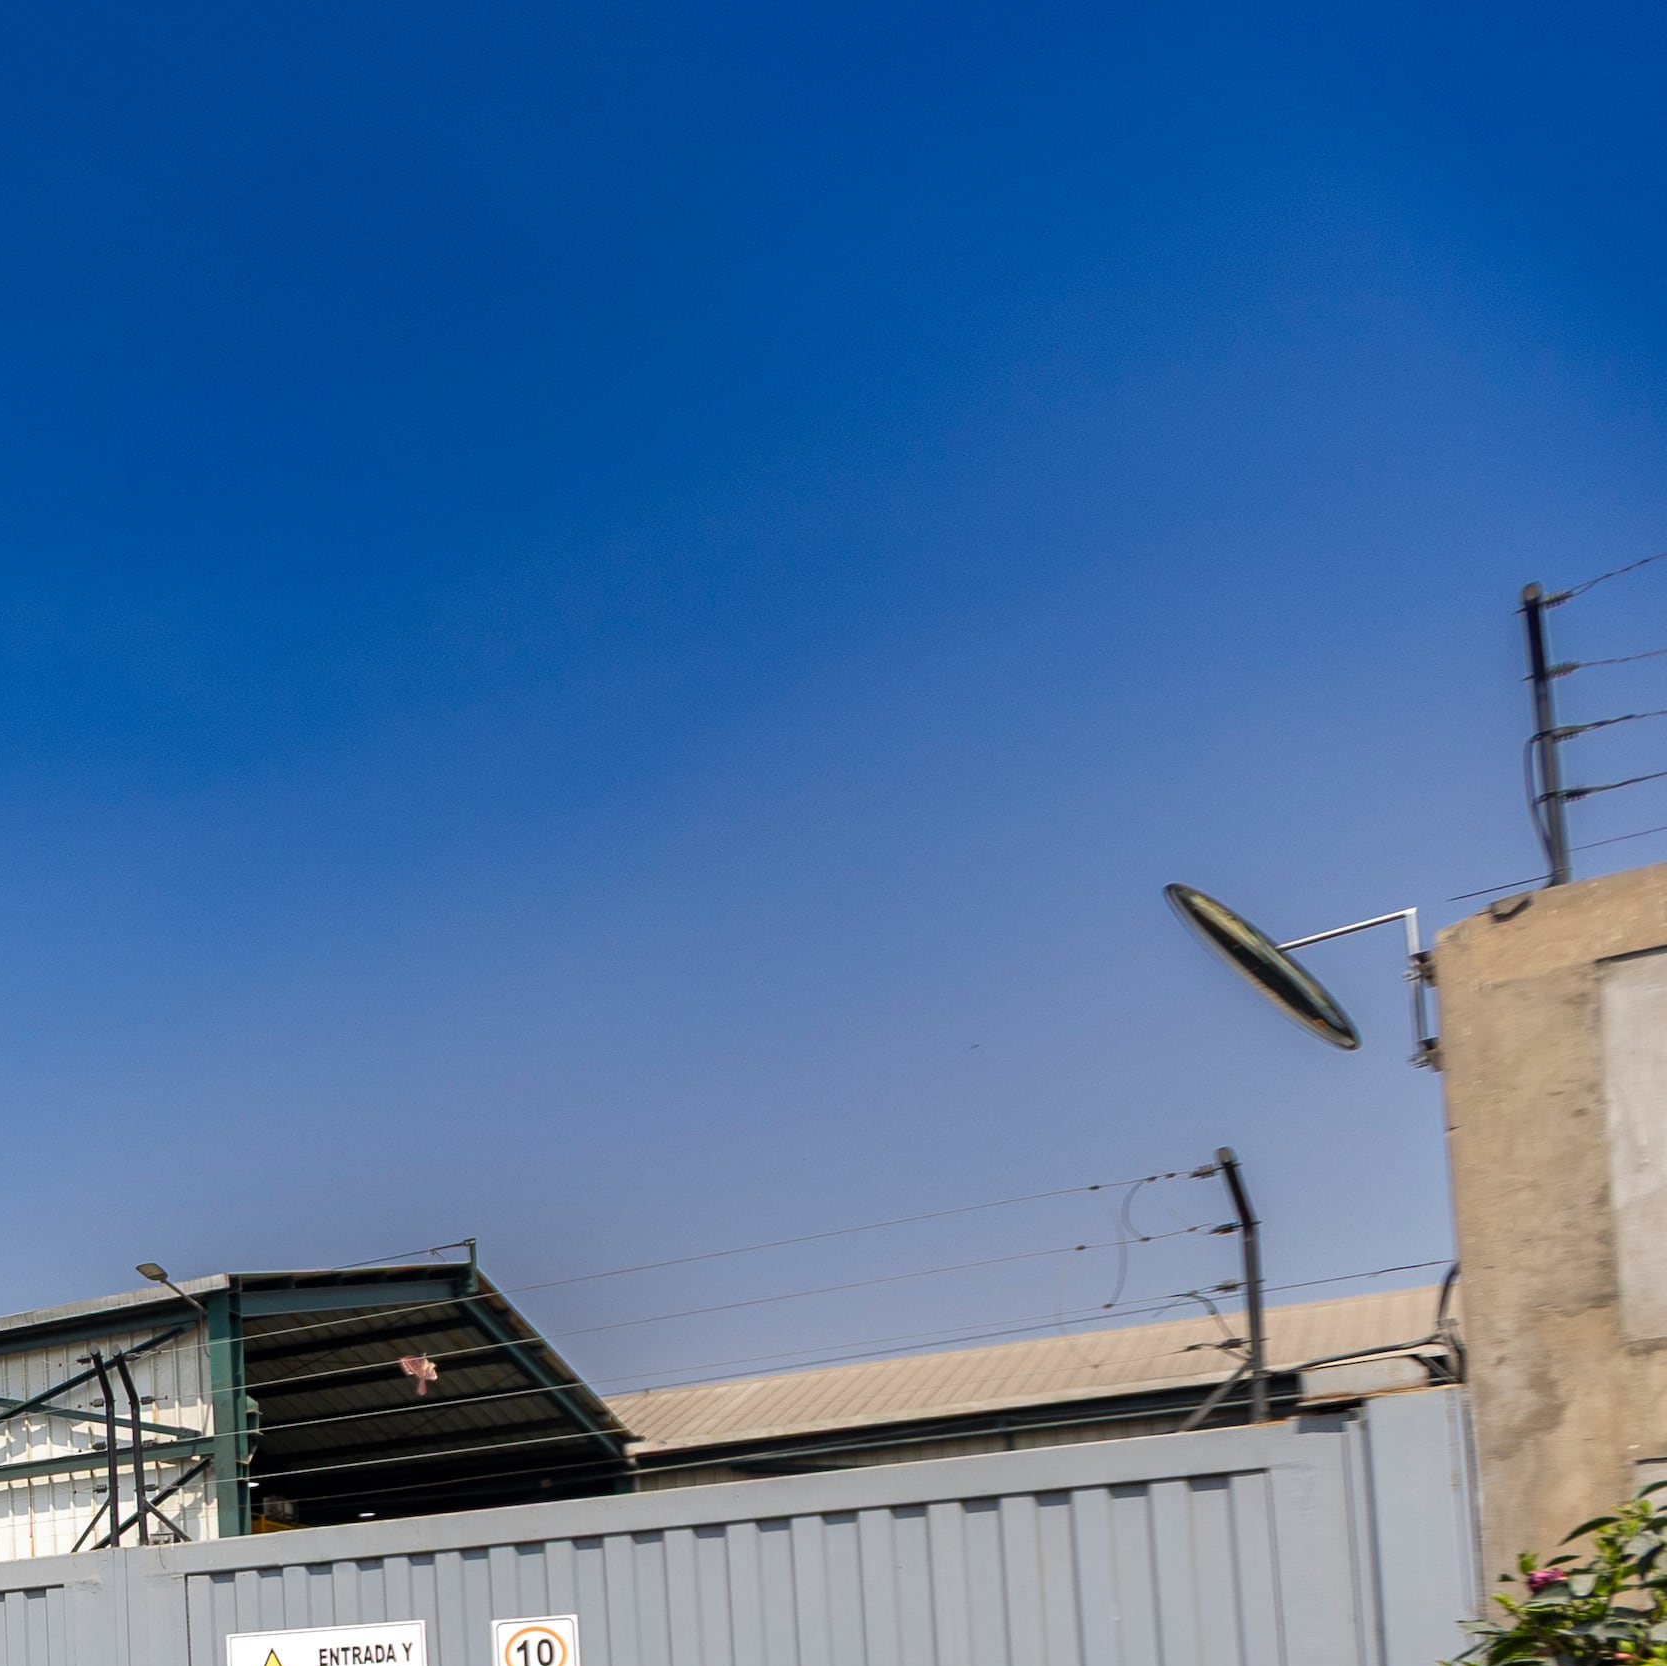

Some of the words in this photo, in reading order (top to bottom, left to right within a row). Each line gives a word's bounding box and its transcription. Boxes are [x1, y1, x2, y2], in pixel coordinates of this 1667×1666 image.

[319, 1644, 396, 1666] ENTRADA
[402, 1642, 412, 1661] Y
[517, 1639, 554, 1666] 10
